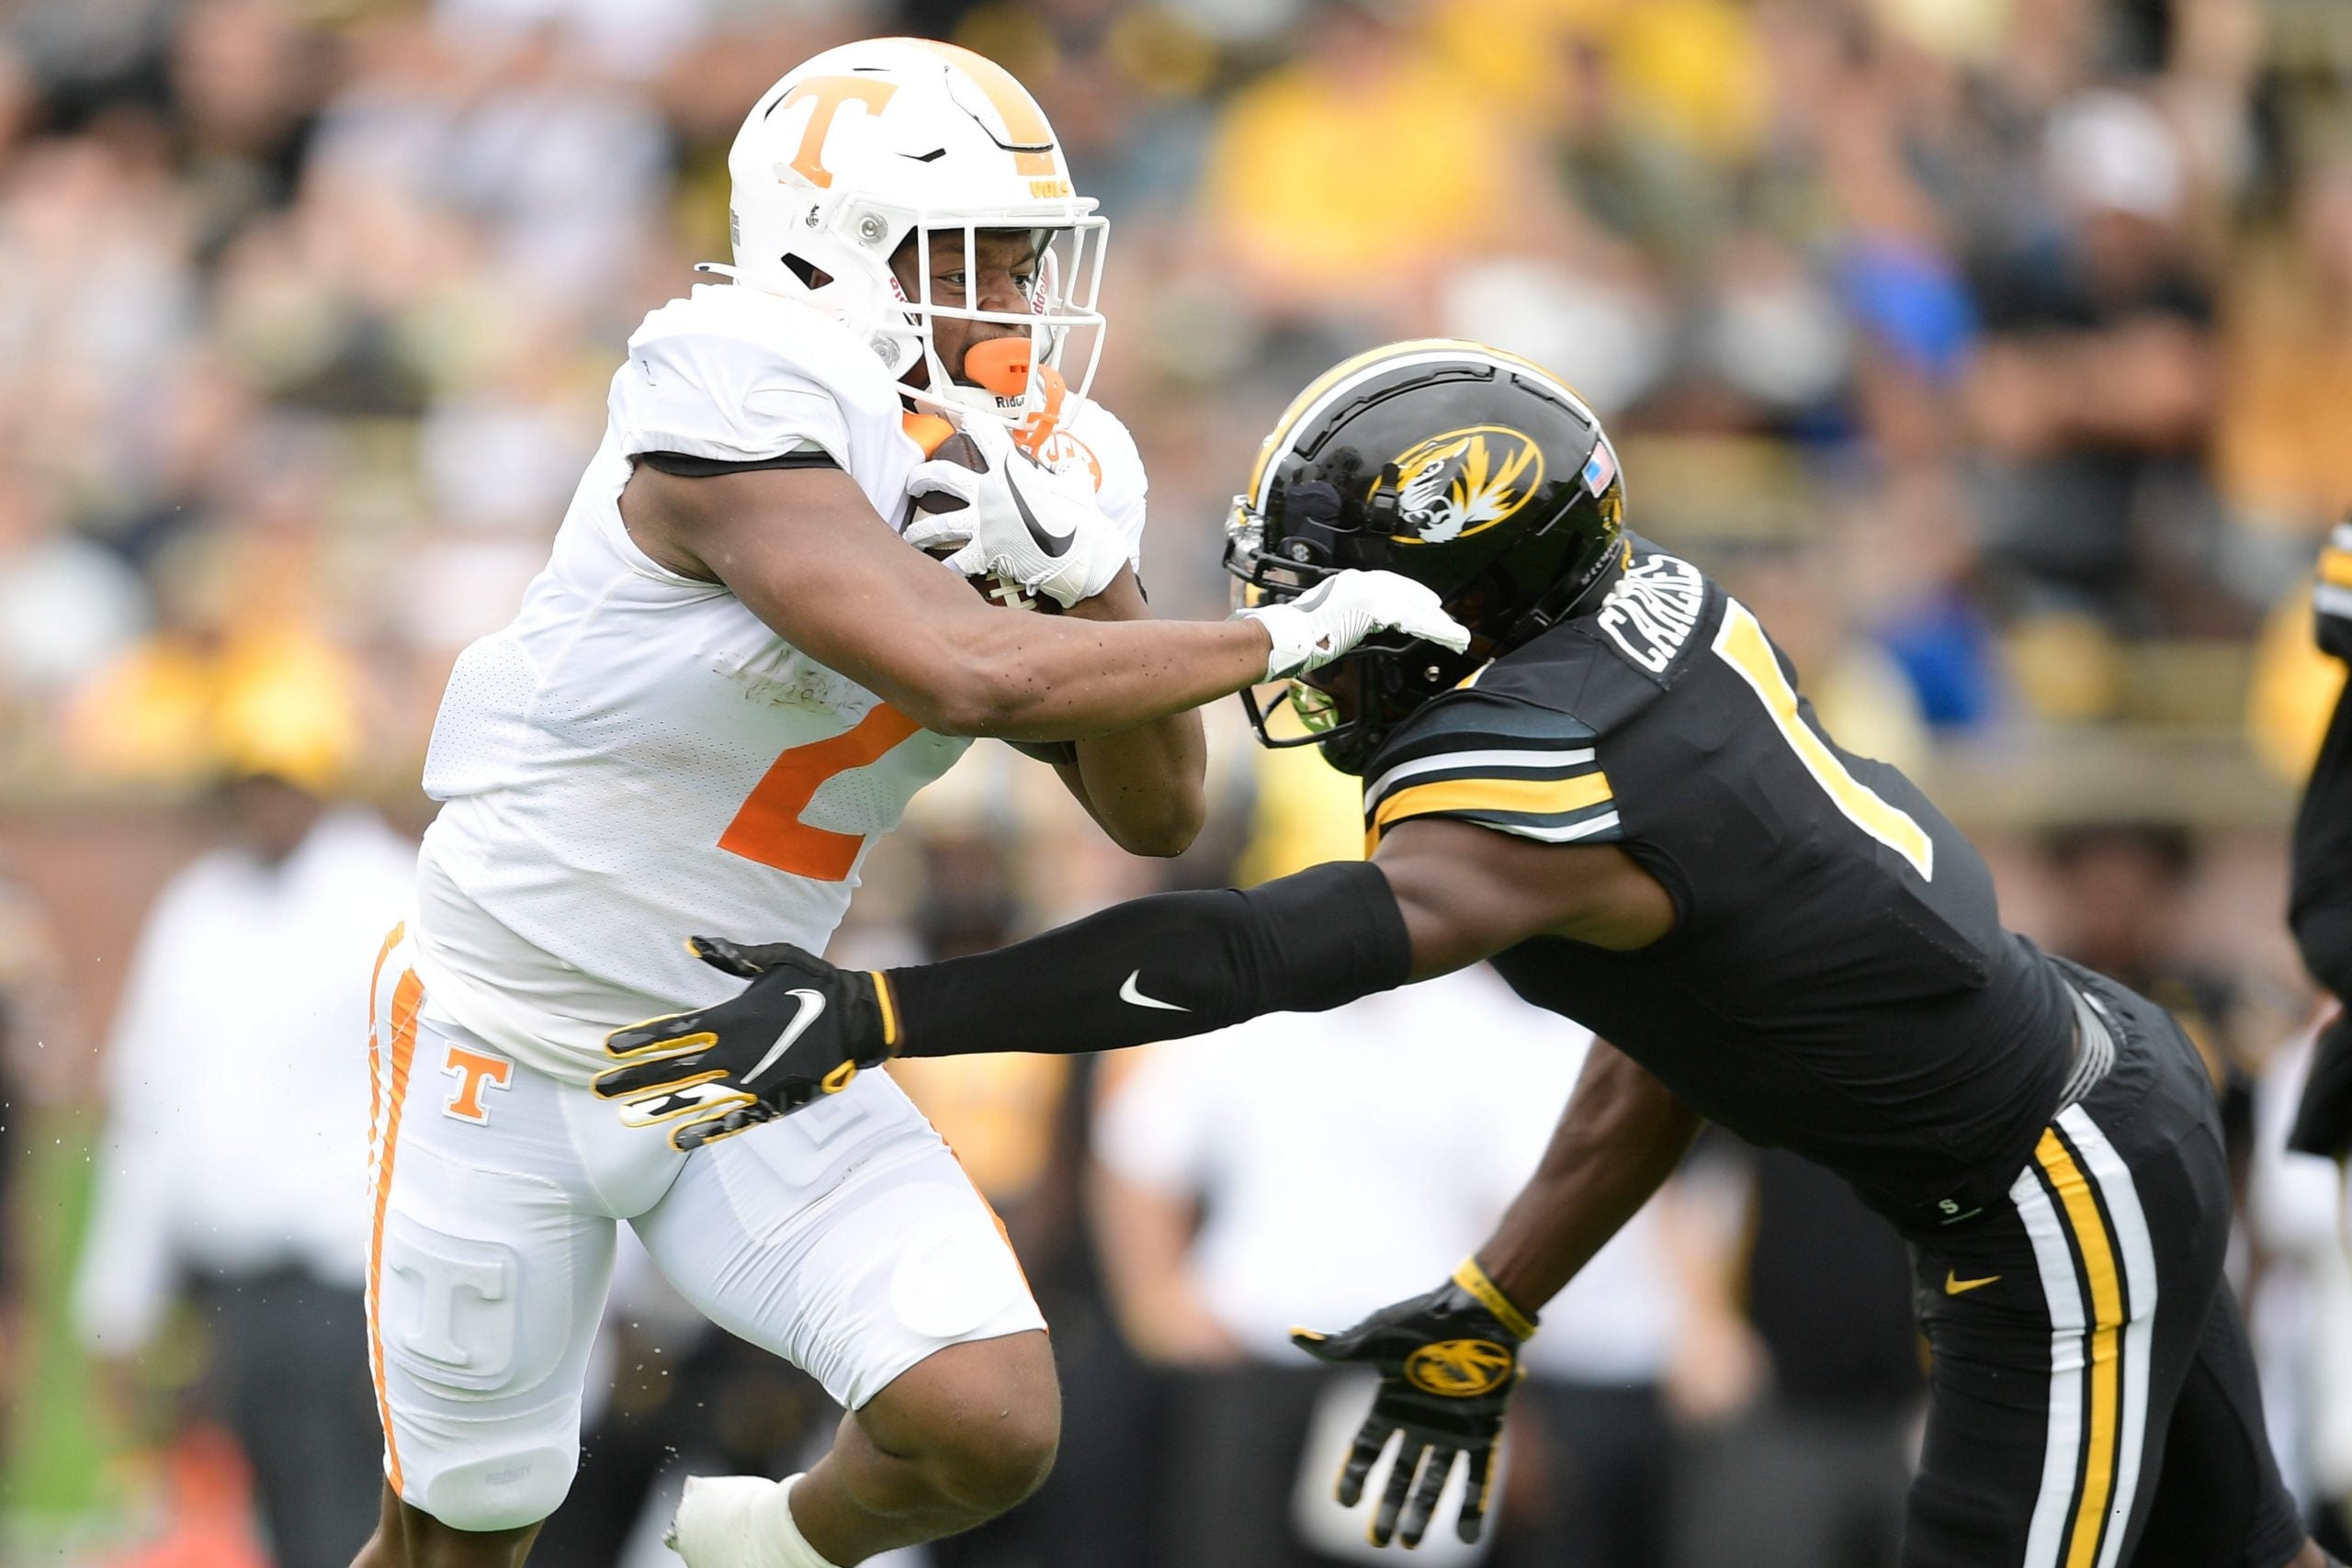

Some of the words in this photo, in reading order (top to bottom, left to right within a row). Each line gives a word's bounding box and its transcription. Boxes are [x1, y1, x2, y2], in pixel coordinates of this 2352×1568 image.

[779, 74, 899, 189] T
[1028, 181, 1069, 199] VOLS
[716, 700, 925, 883] 2
[440, 1040, 515, 1127] T
